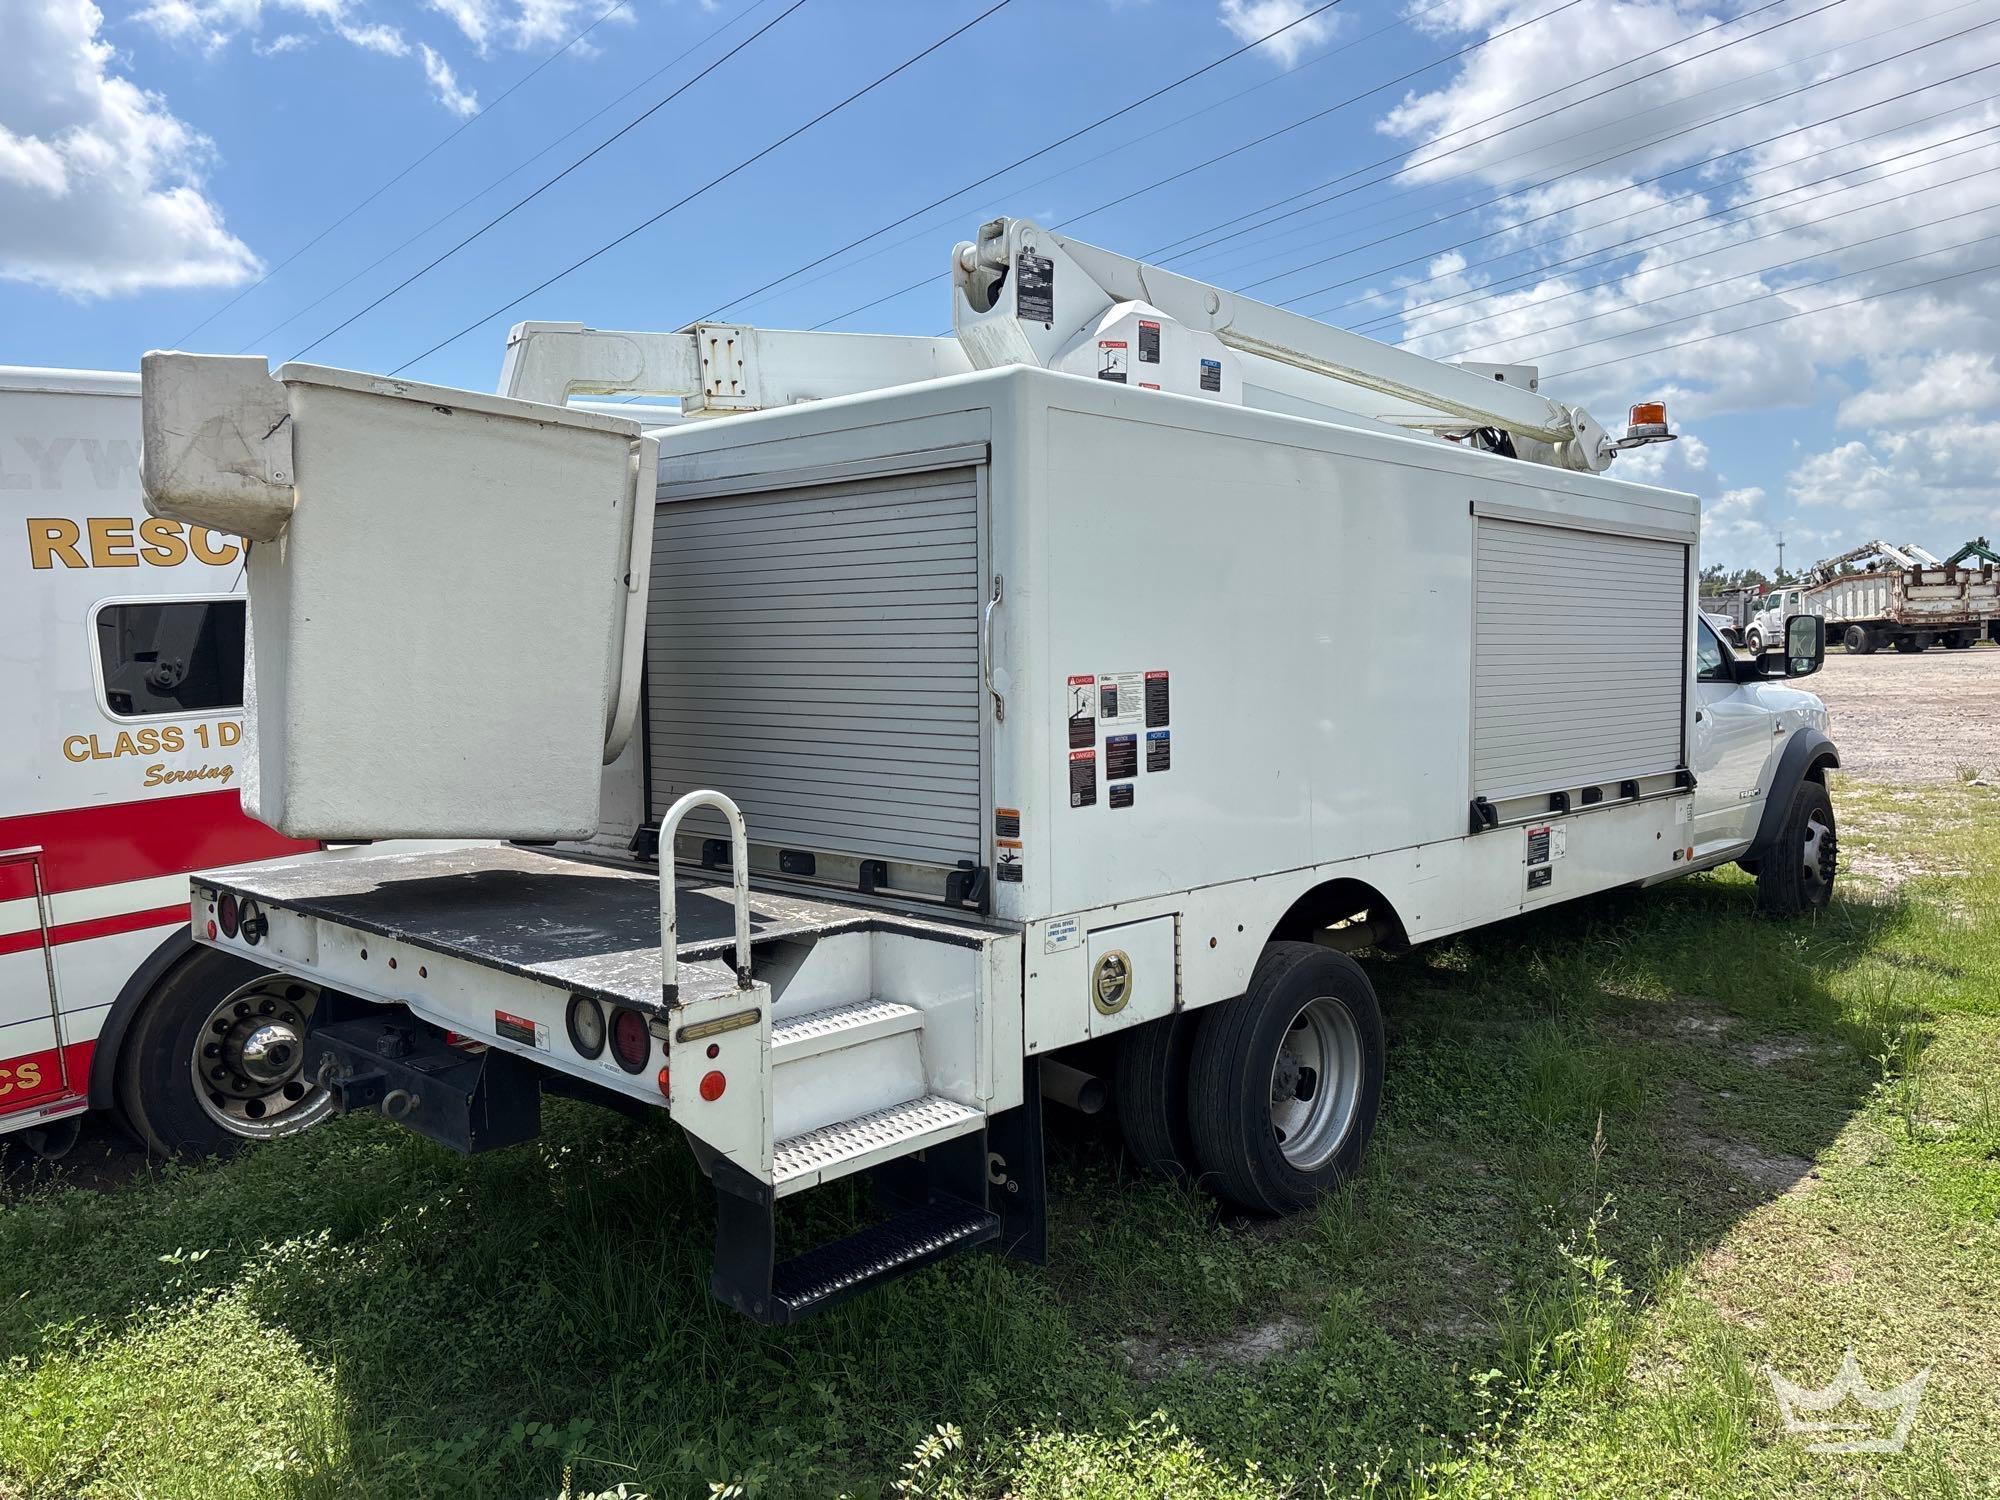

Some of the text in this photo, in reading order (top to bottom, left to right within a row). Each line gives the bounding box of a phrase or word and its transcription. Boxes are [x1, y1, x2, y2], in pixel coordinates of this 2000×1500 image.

[26, 517, 248, 569] RESC
[1075, 676, 1093, 684] DANGER
[63, 720, 243, 763] CLASS 1 D
[1075, 751, 1095, 760] DANGER
[143, 763, 234, 788] Serving
